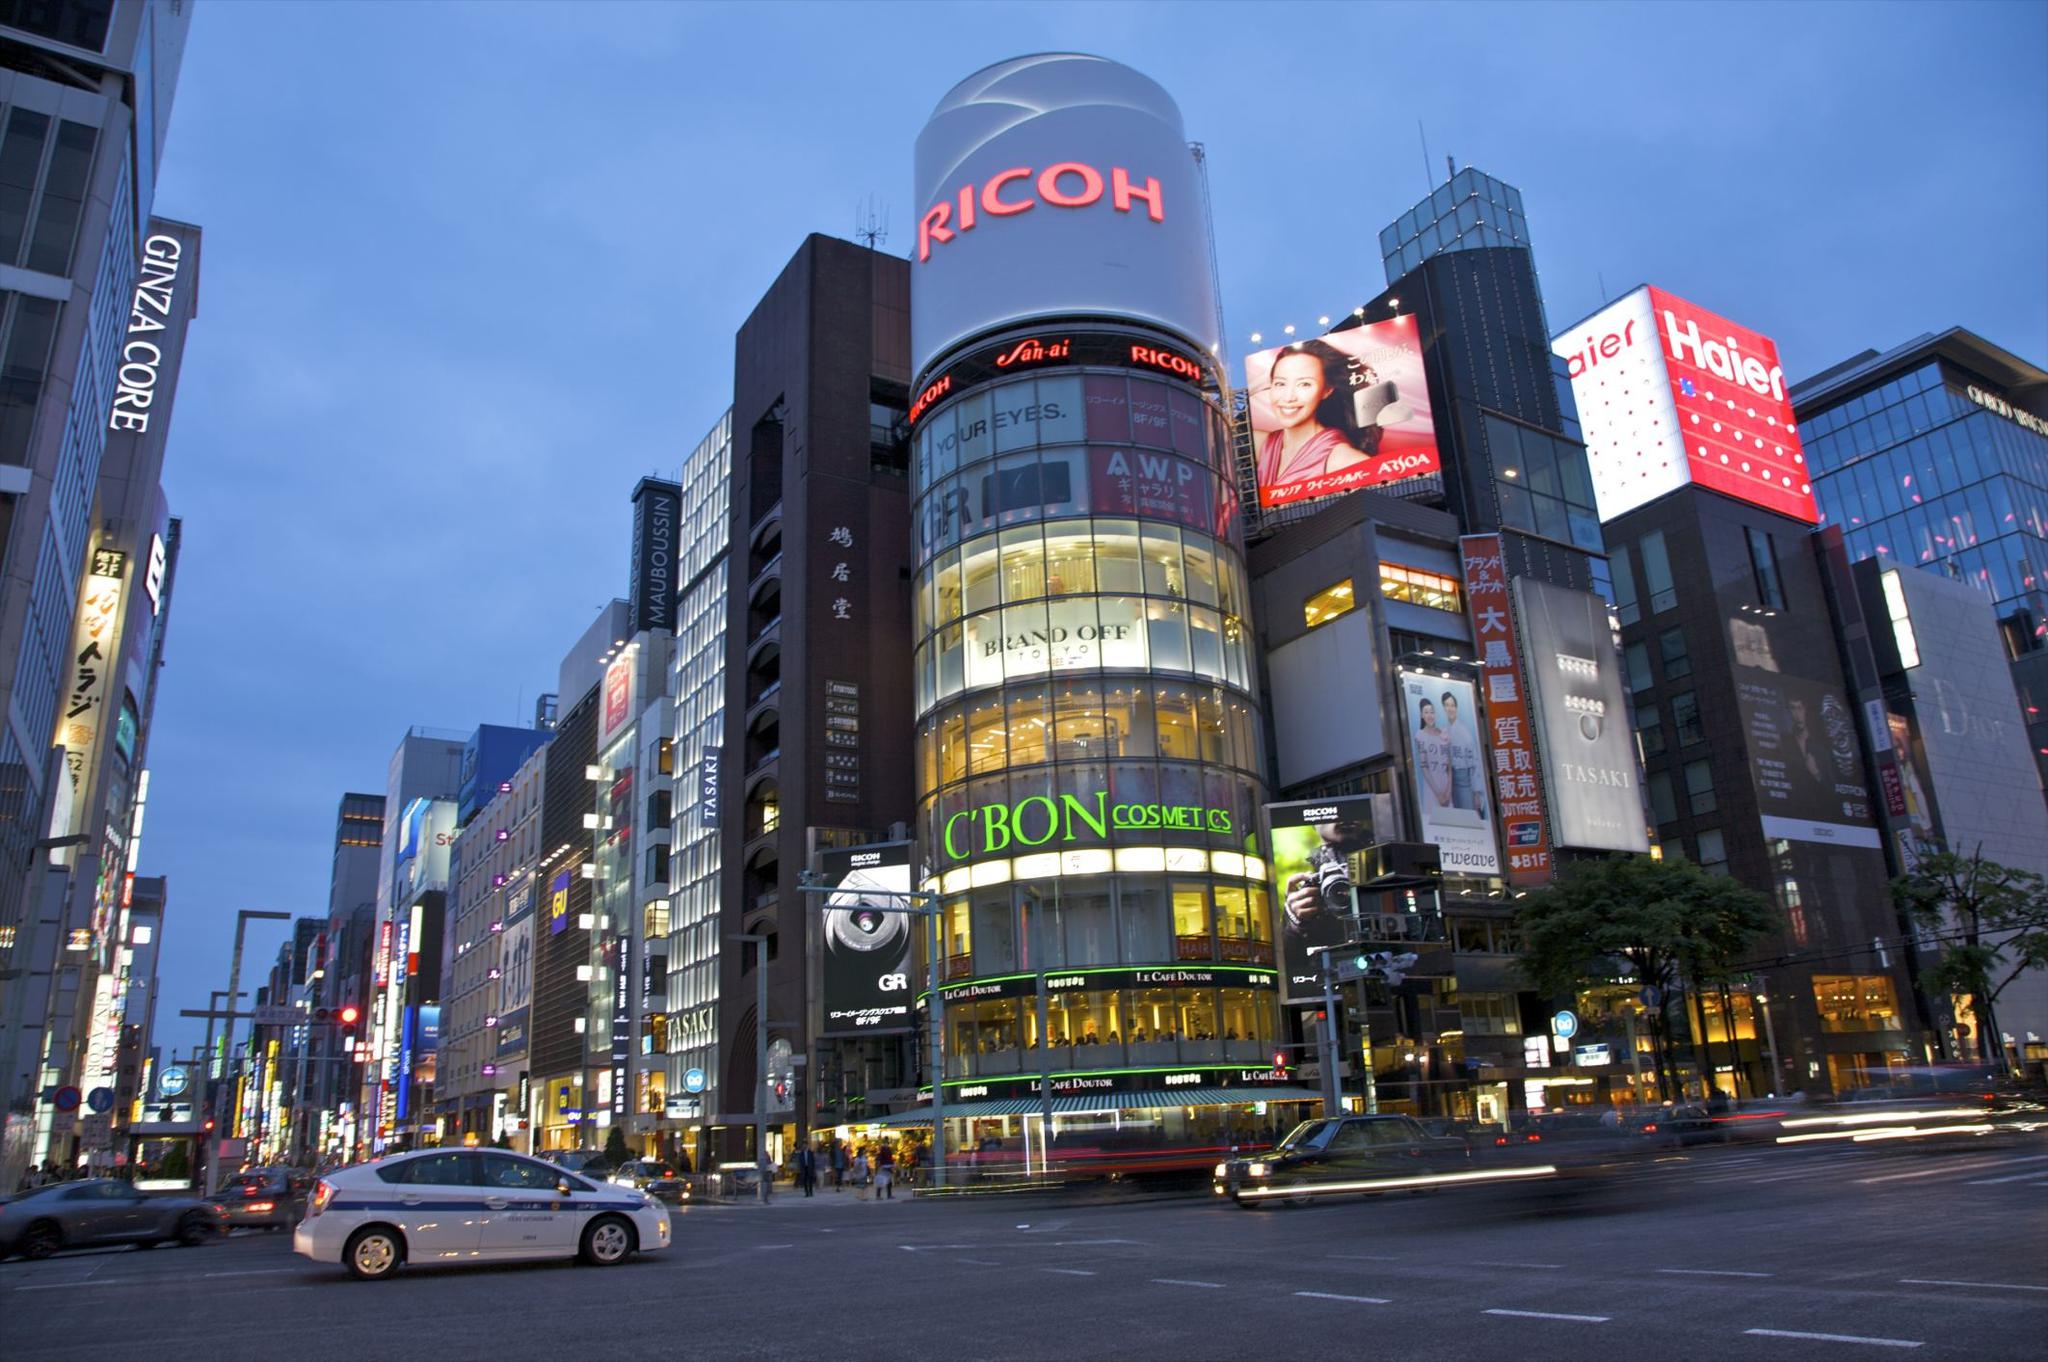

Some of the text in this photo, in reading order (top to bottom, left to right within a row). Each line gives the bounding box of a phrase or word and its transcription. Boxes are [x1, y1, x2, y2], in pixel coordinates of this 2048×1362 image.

[918, 162, 1165, 263] RICOH
[109, 234, 182, 433] GINZA CORE
[996, 339, 1071, 367] San-ai
[1131, 345, 1201, 380] RICOH
[1663, 309, 1784, 401] Haier
[936, 403, 1067, 456] YOUR EYES.
[1378, 453, 1431, 475] ARSOA
[95, 562, 119, 576] 2F
[648, 496, 671, 624] MAUBOUSSIN
[827, 527, 853, 619] 鳩居堂
[1465, 555, 1501, 571] ブランド
[1468, 579, 1505, 595] チケット
[984, 624, 1131, 658] BRAND OFF
[1019, 643, 1089, 661] TOYO
[1477, 605, 1519, 703] 大黒屋
[65, 641, 102, 719] トラジ
[1494, 716, 1524, 745] 質
[1494, 748, 1533, 774] 買取
[1562, 763, 1630, 788] TASAKI
[703, 755, 718, 820] TASAKI
[1499, 774, 1537, 799] 販売
[944, 791, 1233, 860] C'BON COSMETICS
[1303, 806, 1338, 817] RICOH
[850, 852, 881, 863] RICOH
[1521, 852, 1548, 869] B1F
[552, 888, 569, 919] GU
[878, 972, 908, 991] GR
[665, 1006, 714, 1042] TASAKI
